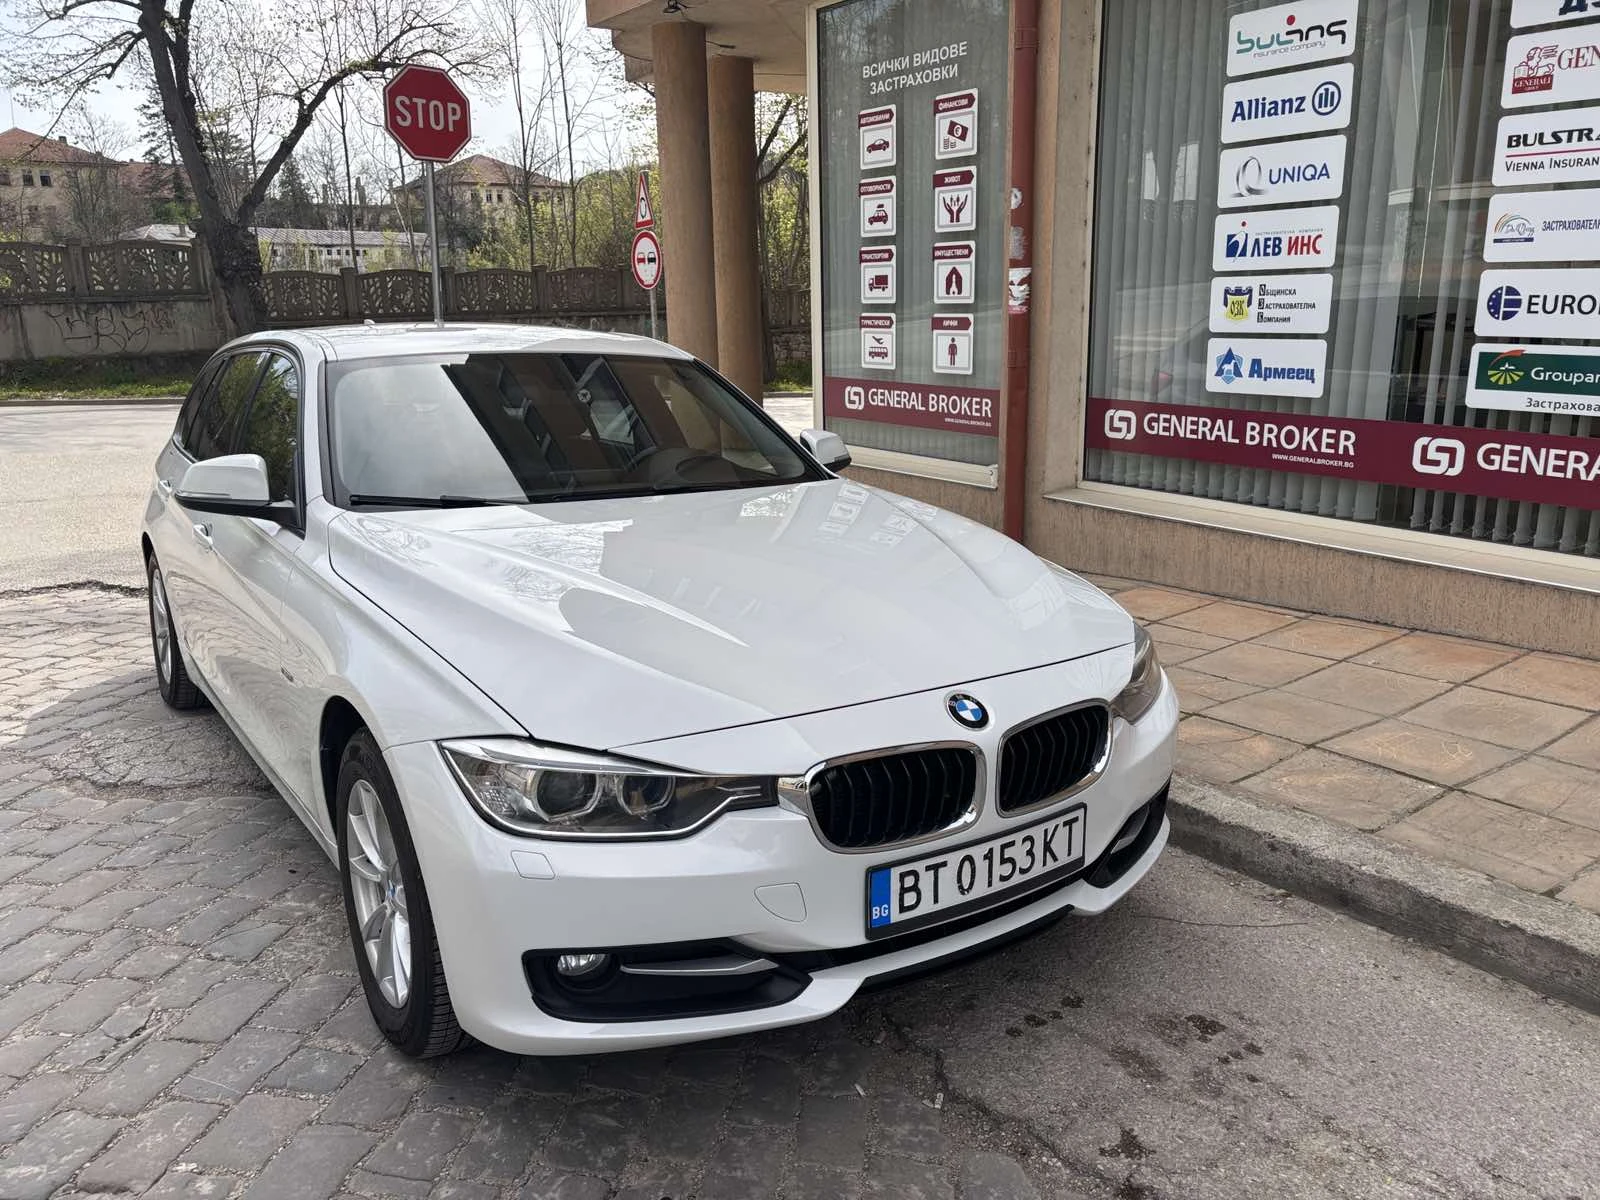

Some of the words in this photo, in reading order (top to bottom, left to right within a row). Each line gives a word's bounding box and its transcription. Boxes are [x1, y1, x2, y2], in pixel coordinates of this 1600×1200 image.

[862, 56, 910, 79] ВСИЧКИ
[912, 41, 968, 67] ВИДОВЕ
[1253, 46, 1289, 59] insurance
[1290, 40, 1326, 52] company
[870, 63, 958, 95] ЗАСТРАХОВКИ
[394, 95, 462, 133] STOP
[1231, 96, 1306, 123] Allianz
[1507, 128, 1600, 148] BULSTR
[1268, 162, 1331, 185] UNIQA
[1250, 237, 1282, 257] ЛЕВ
[1287, 234, 1323, 256] ИНС
[1248, 358, 1316, 384] Армеец
[868, 388, 926, 412] GENERAL
[928, 393, 992, 418] BROKER
[1525, 397, 1600, 412] Застрахова
[1143, 412, 1240, 444] GENERAL
[1245, 421, 1356, 457] BROKER
[1271, 453, 1355, 468] WWW.GENERALBROKER.BG
[872, 903, 889, 920] BG
